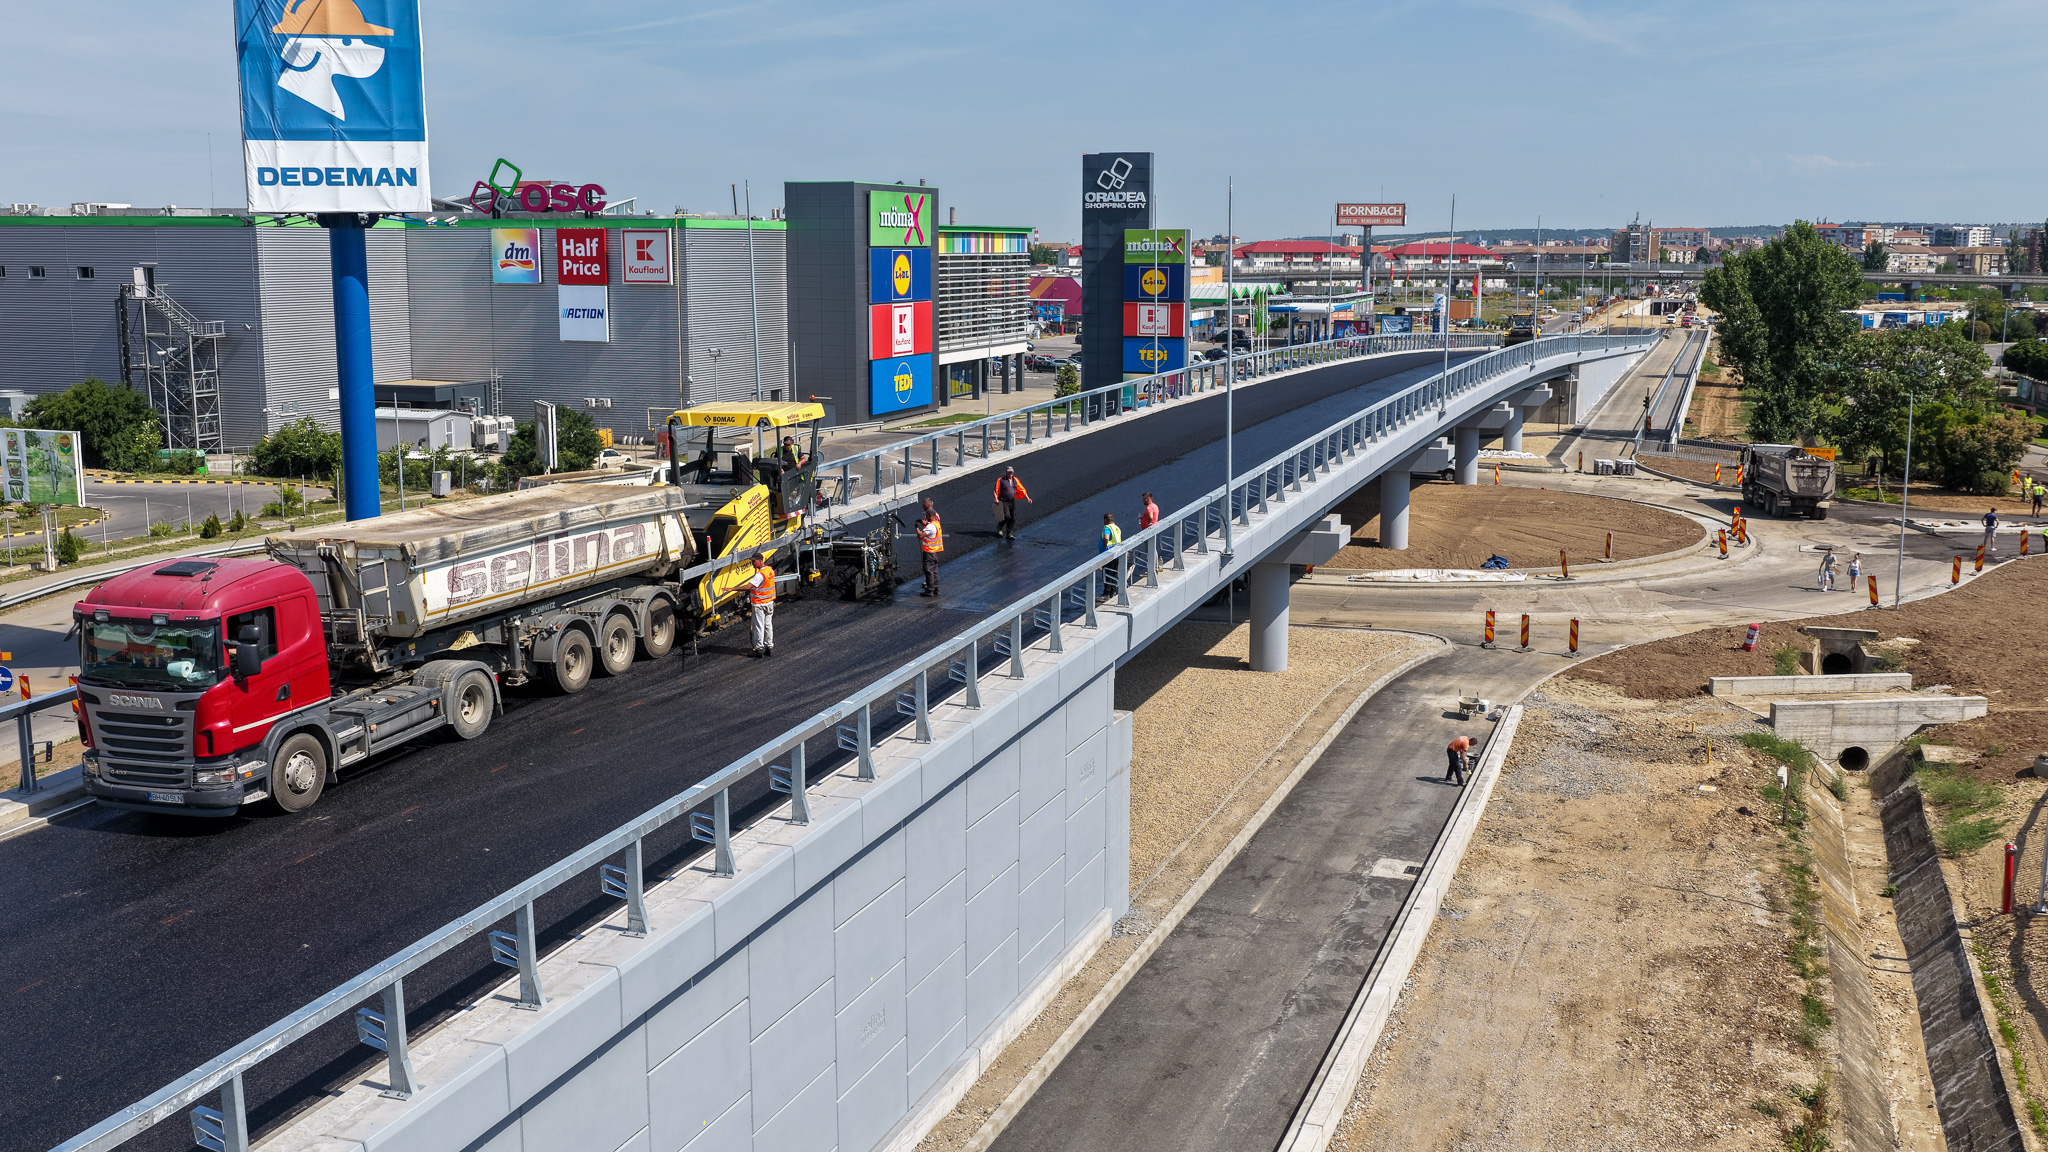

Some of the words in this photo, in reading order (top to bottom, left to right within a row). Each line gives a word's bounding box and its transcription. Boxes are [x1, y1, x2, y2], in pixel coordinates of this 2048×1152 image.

[257, 167, 417, 187] DEDEMAN
[520, 183, 607, 212] OSC
[1084, 191, 1147, 202] ORADEA
[1340, 205, 1402, 216] HORNBACH
[505, 242, 530, 260] dm
[561, 237, 599, 257] Half
[562, 259, 601, 276] Price
[628, 265, 664, 274] Kaufland
[566, 308, 605, 319] ACTION
[1138, 350, 1168, 361] TEDi
[894, 374, 913, 393] TEDi
[447, 523, 646, 606] selina
[530, 602, 556, 616] SCHMITZ
[110, 694, 163, 710] SCANIA
